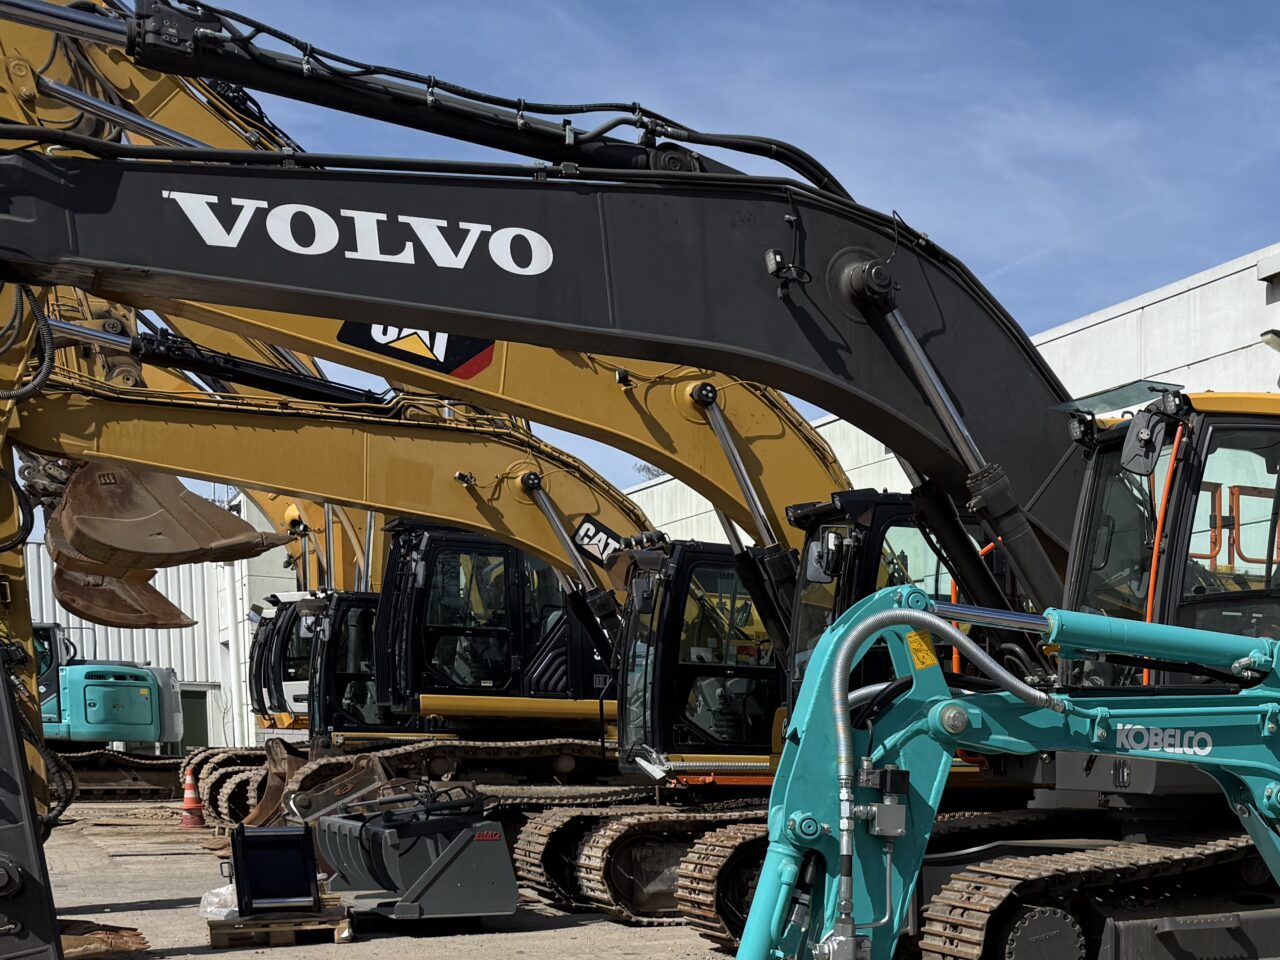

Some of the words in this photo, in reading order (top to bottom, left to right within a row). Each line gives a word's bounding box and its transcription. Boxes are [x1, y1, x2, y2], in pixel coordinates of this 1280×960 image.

[161, 190, 554, 276] VOLVO
[575, 522, 621, 561] CAT
[1115, 722, 1213, 757] KOBELCO
